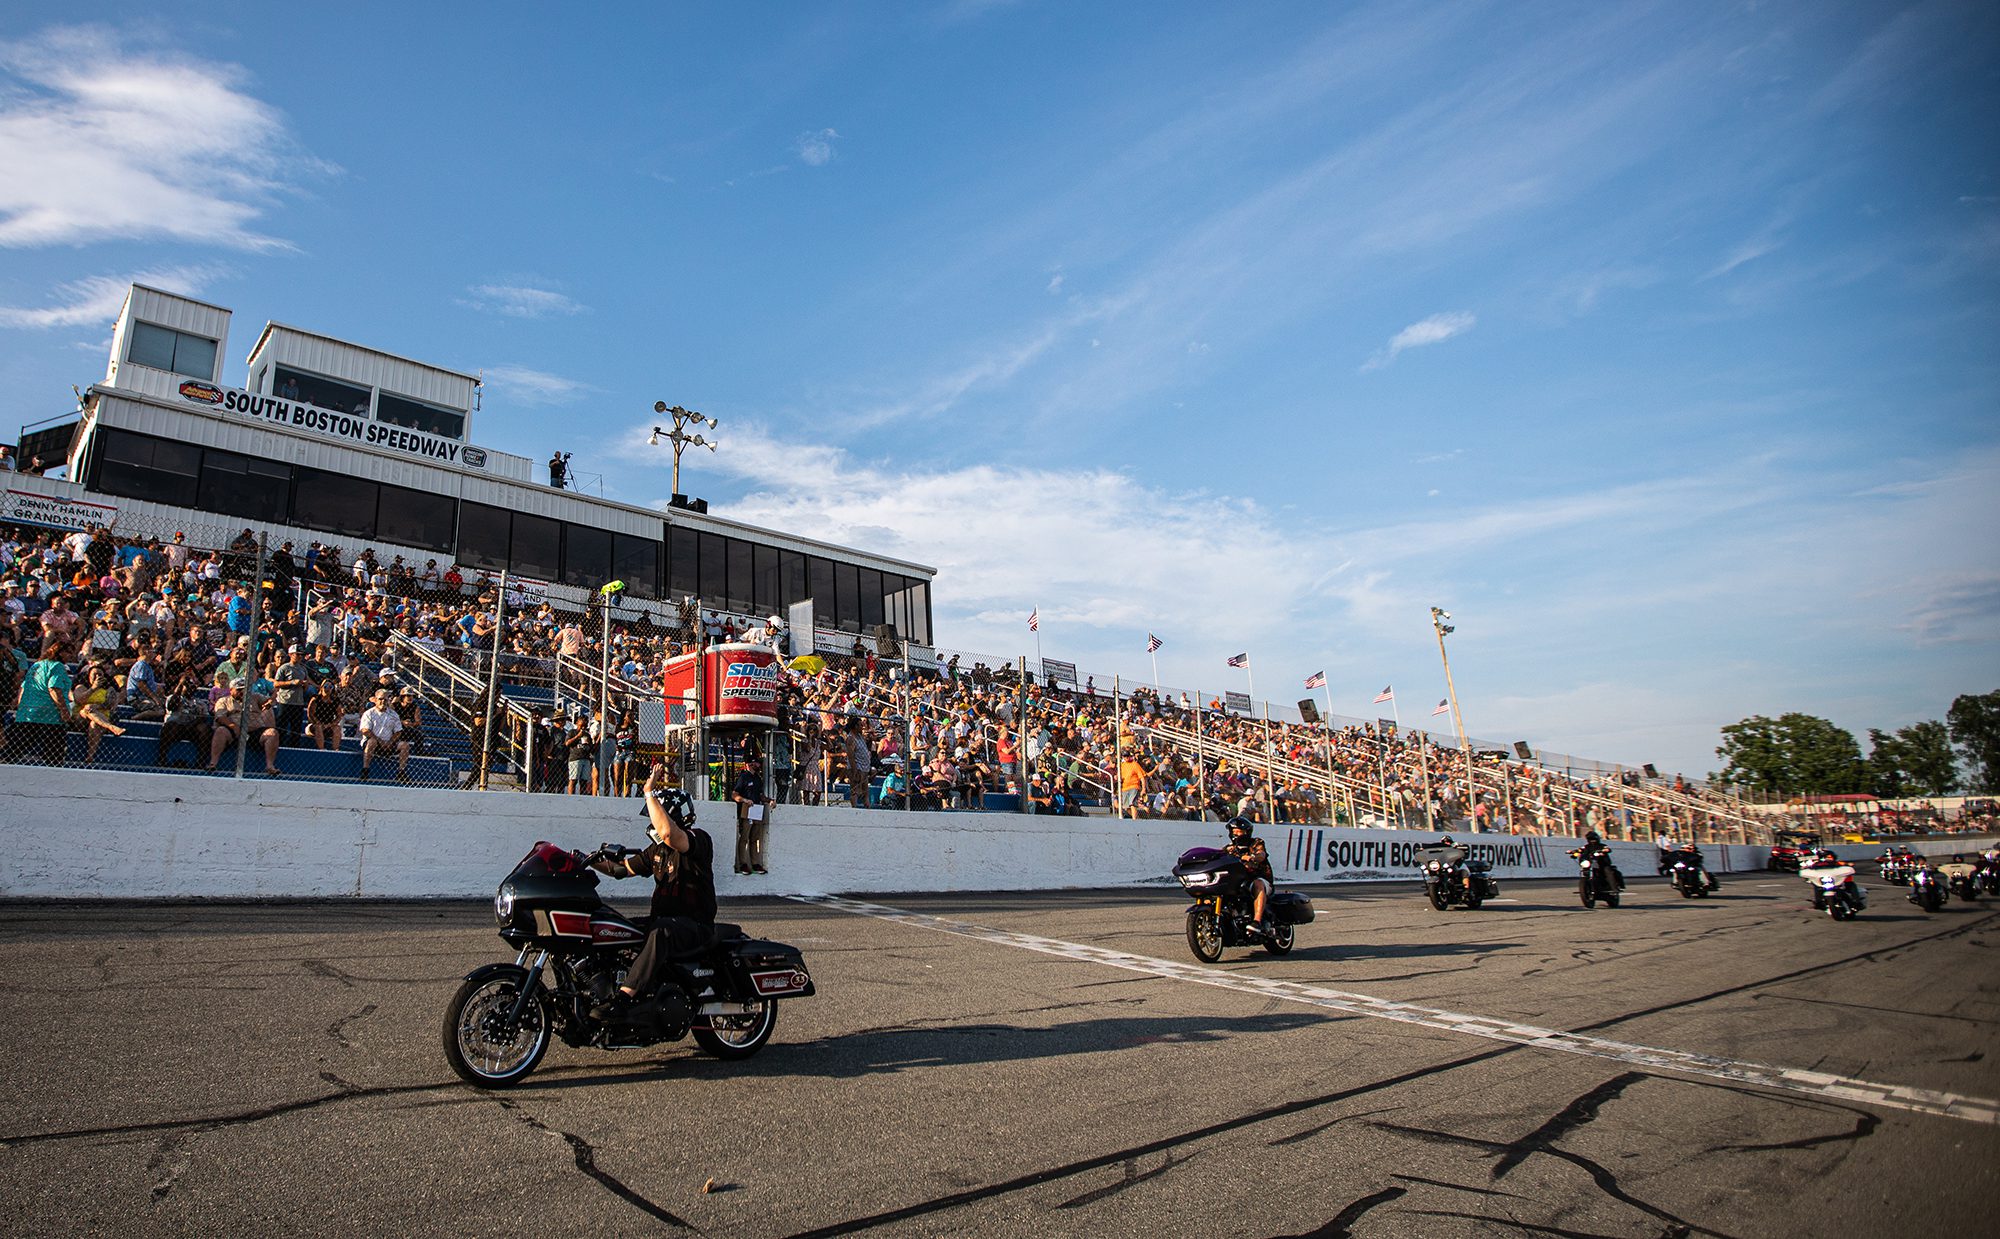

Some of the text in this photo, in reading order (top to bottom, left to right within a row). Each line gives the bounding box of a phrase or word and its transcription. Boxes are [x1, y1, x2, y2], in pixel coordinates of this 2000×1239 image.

[224, 390, 289, 422] SOUTH
[292, 405, 364, 440] BOSTON
[366, 423, 460, 461] SPEEDWAY
[14, 508, 105, 530] GRANDSTAND
[20, 498, 103, 519] DENNY HAMLIN
[728, 663, 774, 677] SOUTH
[722, 688, 775, 698] SPEEDWAY
[724, 676, 776, 690] BOSTON
[1327, 840, 1522, 868] SOUTH BOS PEEDWAY
